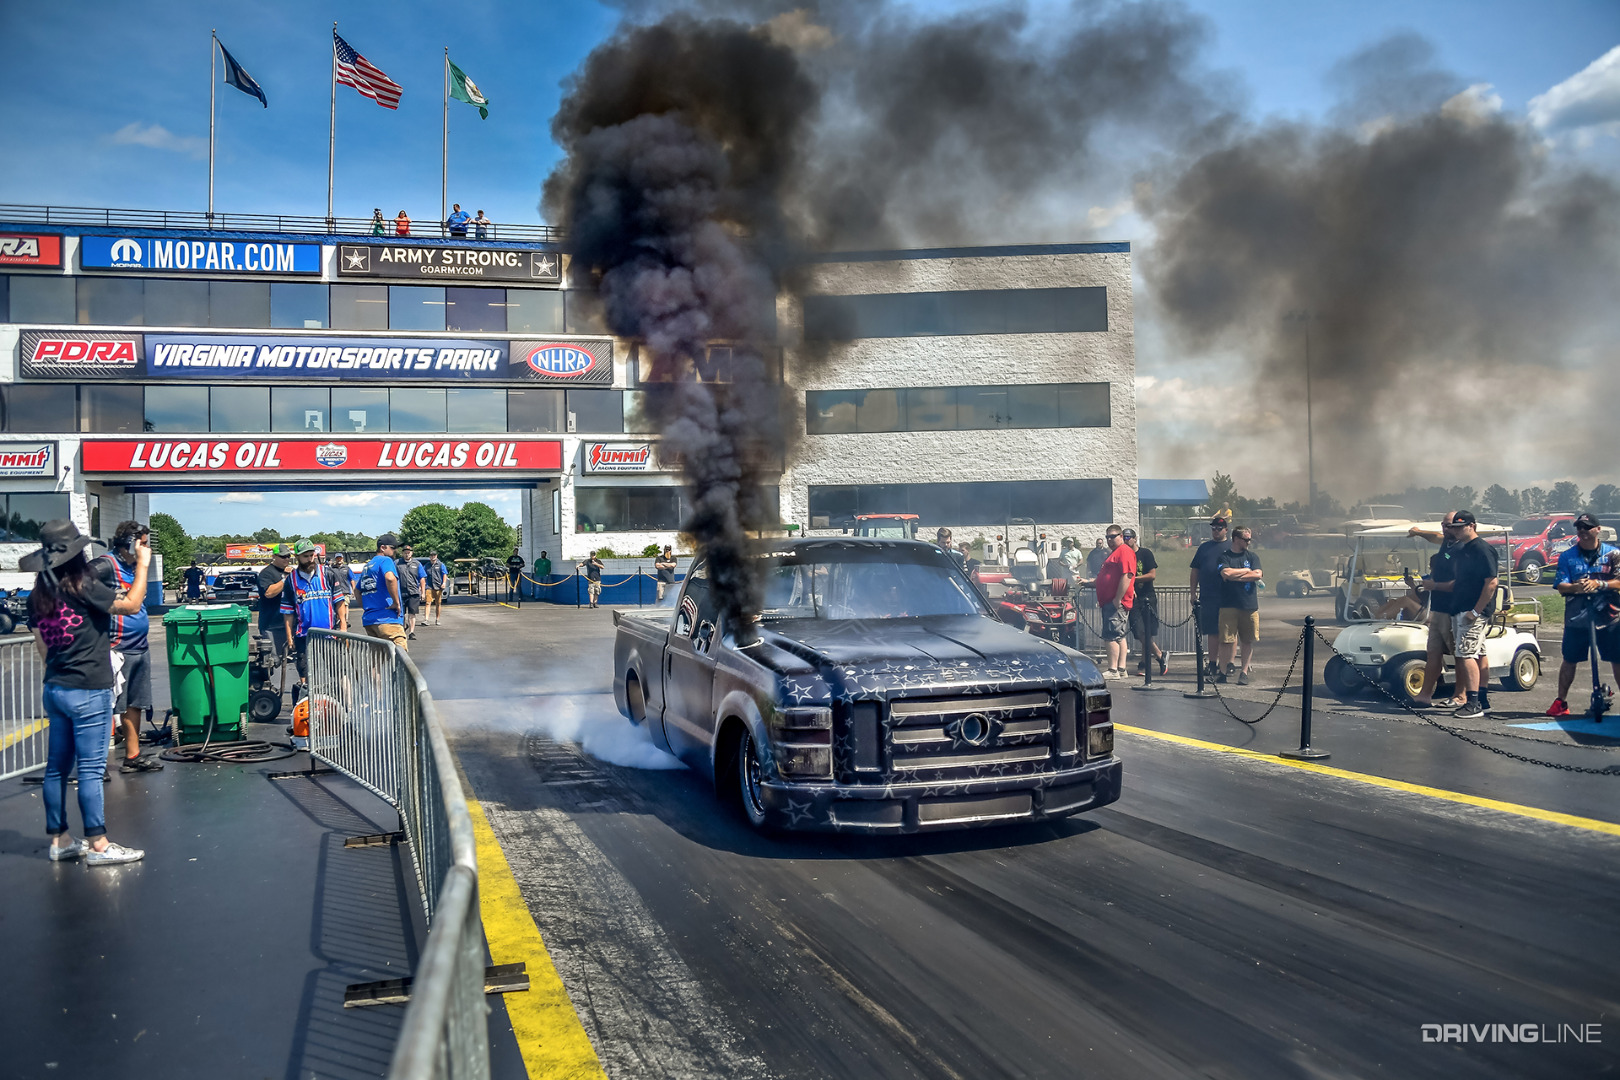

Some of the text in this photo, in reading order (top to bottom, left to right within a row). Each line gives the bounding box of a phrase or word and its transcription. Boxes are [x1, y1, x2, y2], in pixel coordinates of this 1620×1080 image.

[154, 240, 295, 272] MOPAR.COM
[379, 247, 436, 264] ARMY
[420, 265, 483, 275] GOARMY.COM
[32, 340, 136, 362] PDRA
[153, 343, 501, 370] VIRGINIA MOTORSPORTS PARK
[537, 348, 586, 373] NHRA
[129, 441, 281, 469] LUCAS OIL
[376, 441, 518, 468] LUCAS OIL
[591, 444, 648, 467] SUMMIT
